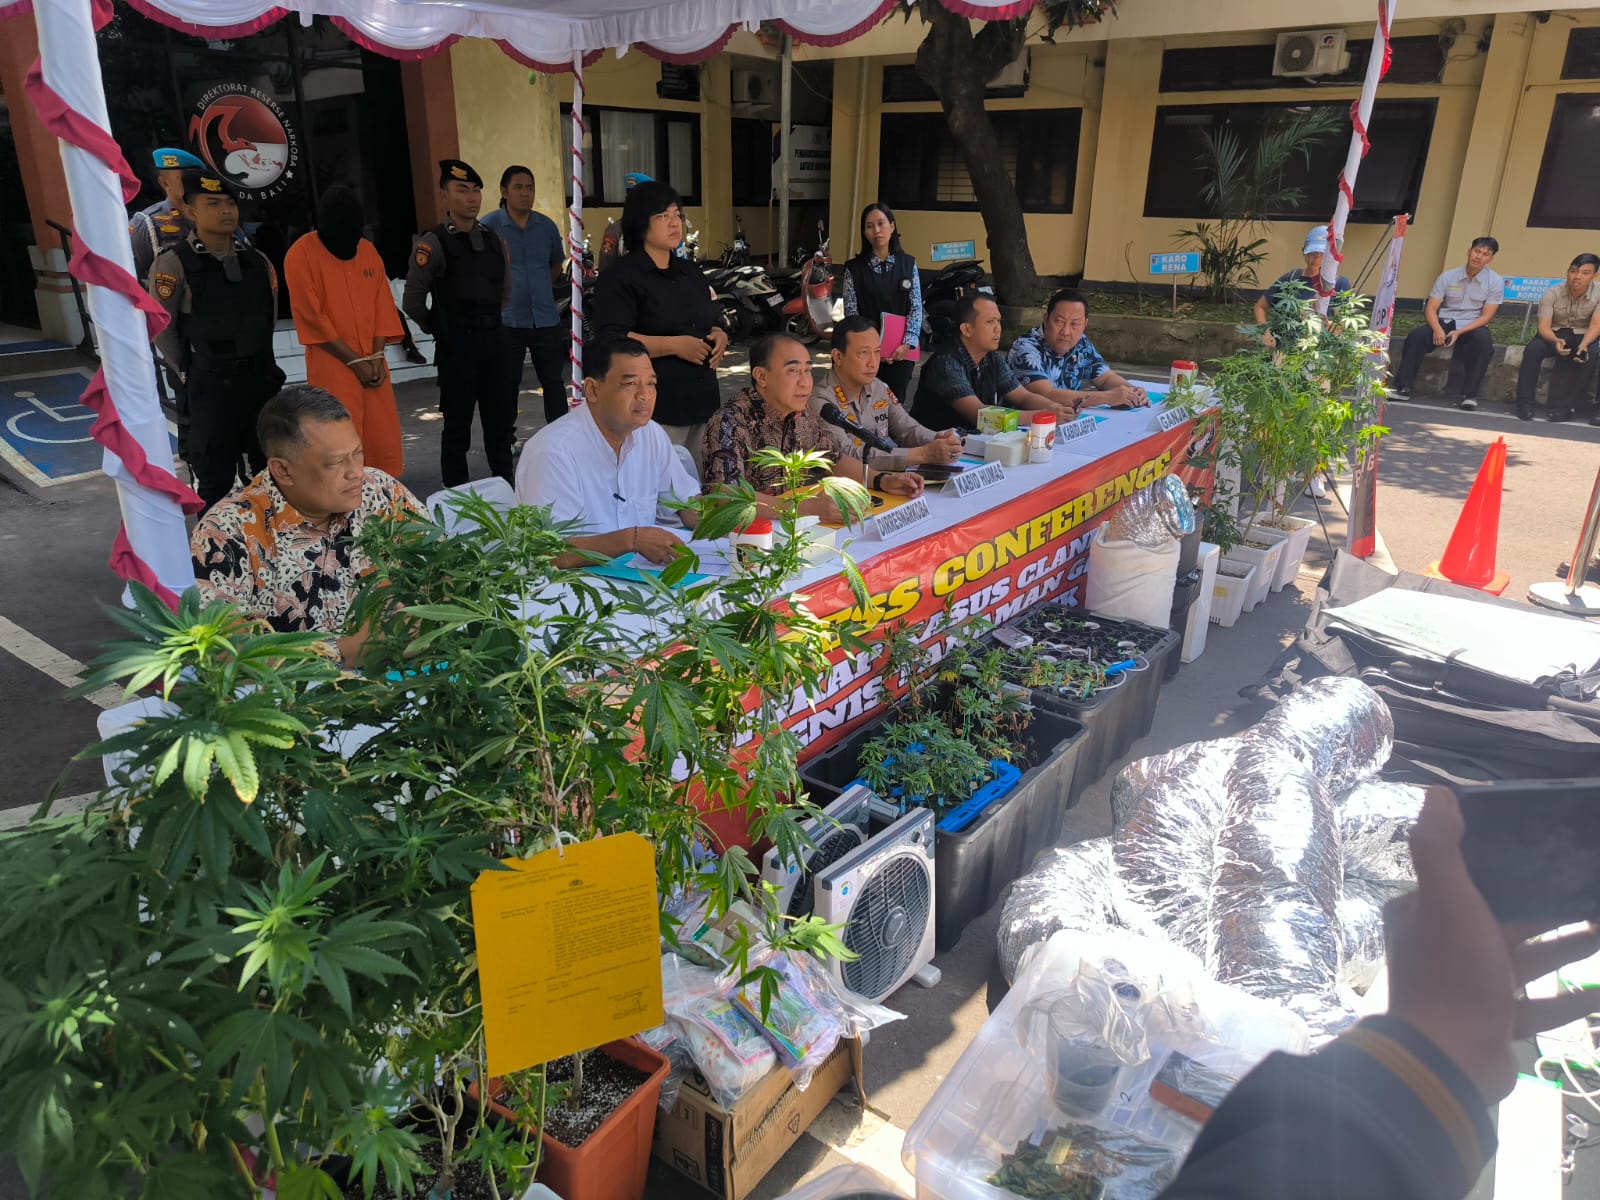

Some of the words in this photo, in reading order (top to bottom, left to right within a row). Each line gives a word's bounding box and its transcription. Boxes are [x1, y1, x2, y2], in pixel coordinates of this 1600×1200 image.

[197, 83, 248, 111] DIREKTORAT
[250, 87, 285, 118] RESERSE
[282, 119, 298, 167] NARKOBA
[260, 180, 288, 200] BALI
[955, 471, 982, 496] KABID
[978, 462, 1006, 488] HUMAS
[933, 448, 1172, 597] CONFERENCE
